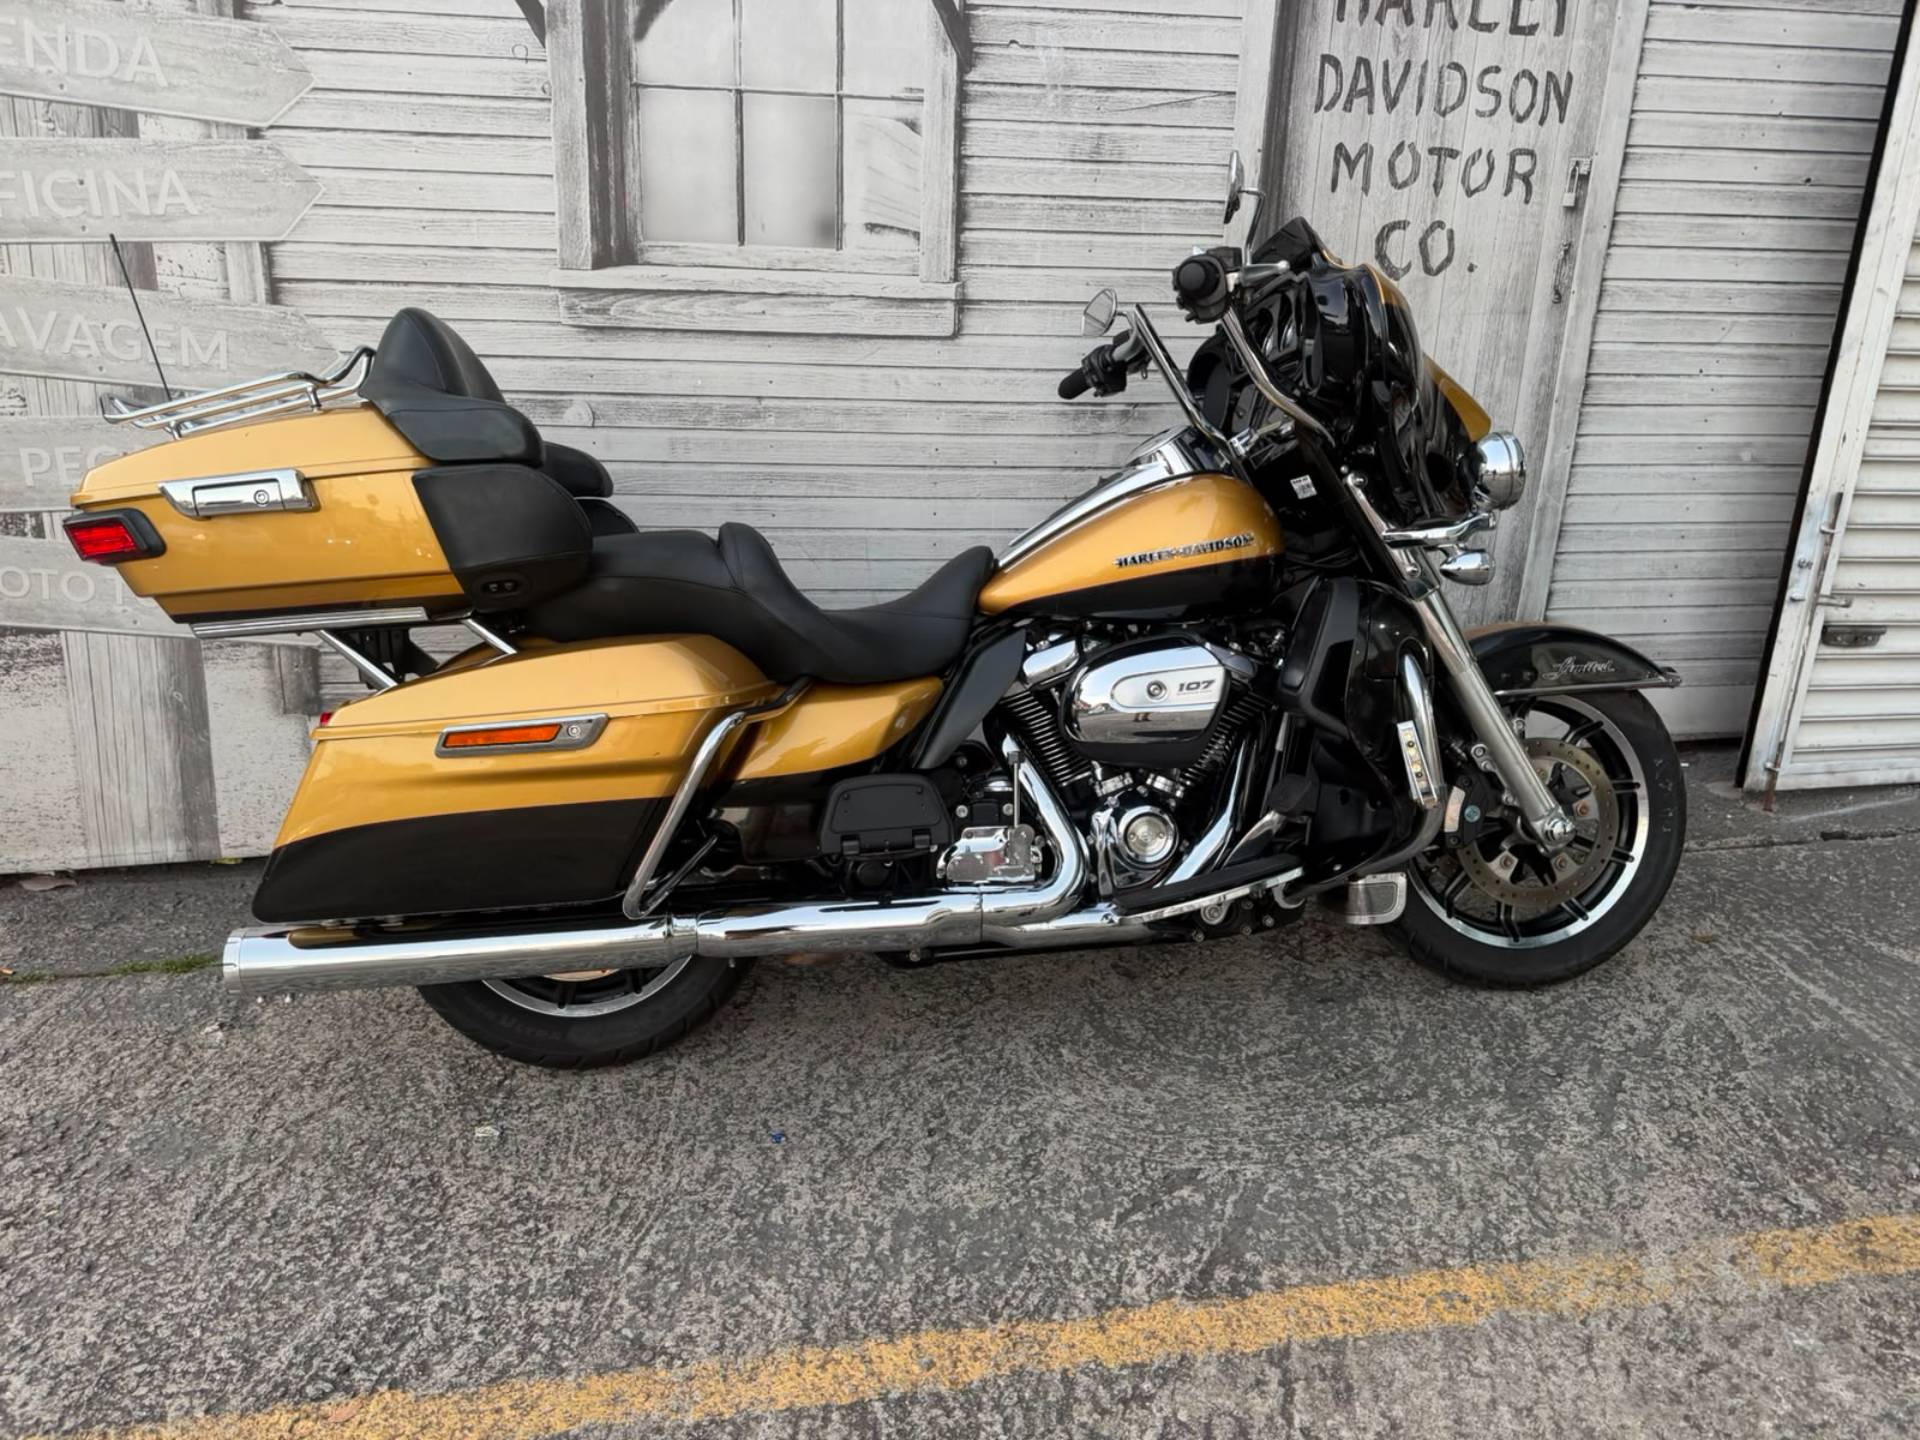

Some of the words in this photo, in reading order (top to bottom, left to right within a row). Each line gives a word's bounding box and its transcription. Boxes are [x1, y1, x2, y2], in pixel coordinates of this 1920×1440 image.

[1313, 53, 1573, 126] DAVIDSON
[0, 168, 199, 218] FICINA
[1331, 141, 1538, 204] MOTOR
[1374, 219, 1478, 281] CO.
[1178, 679, 1216, 692] 107
